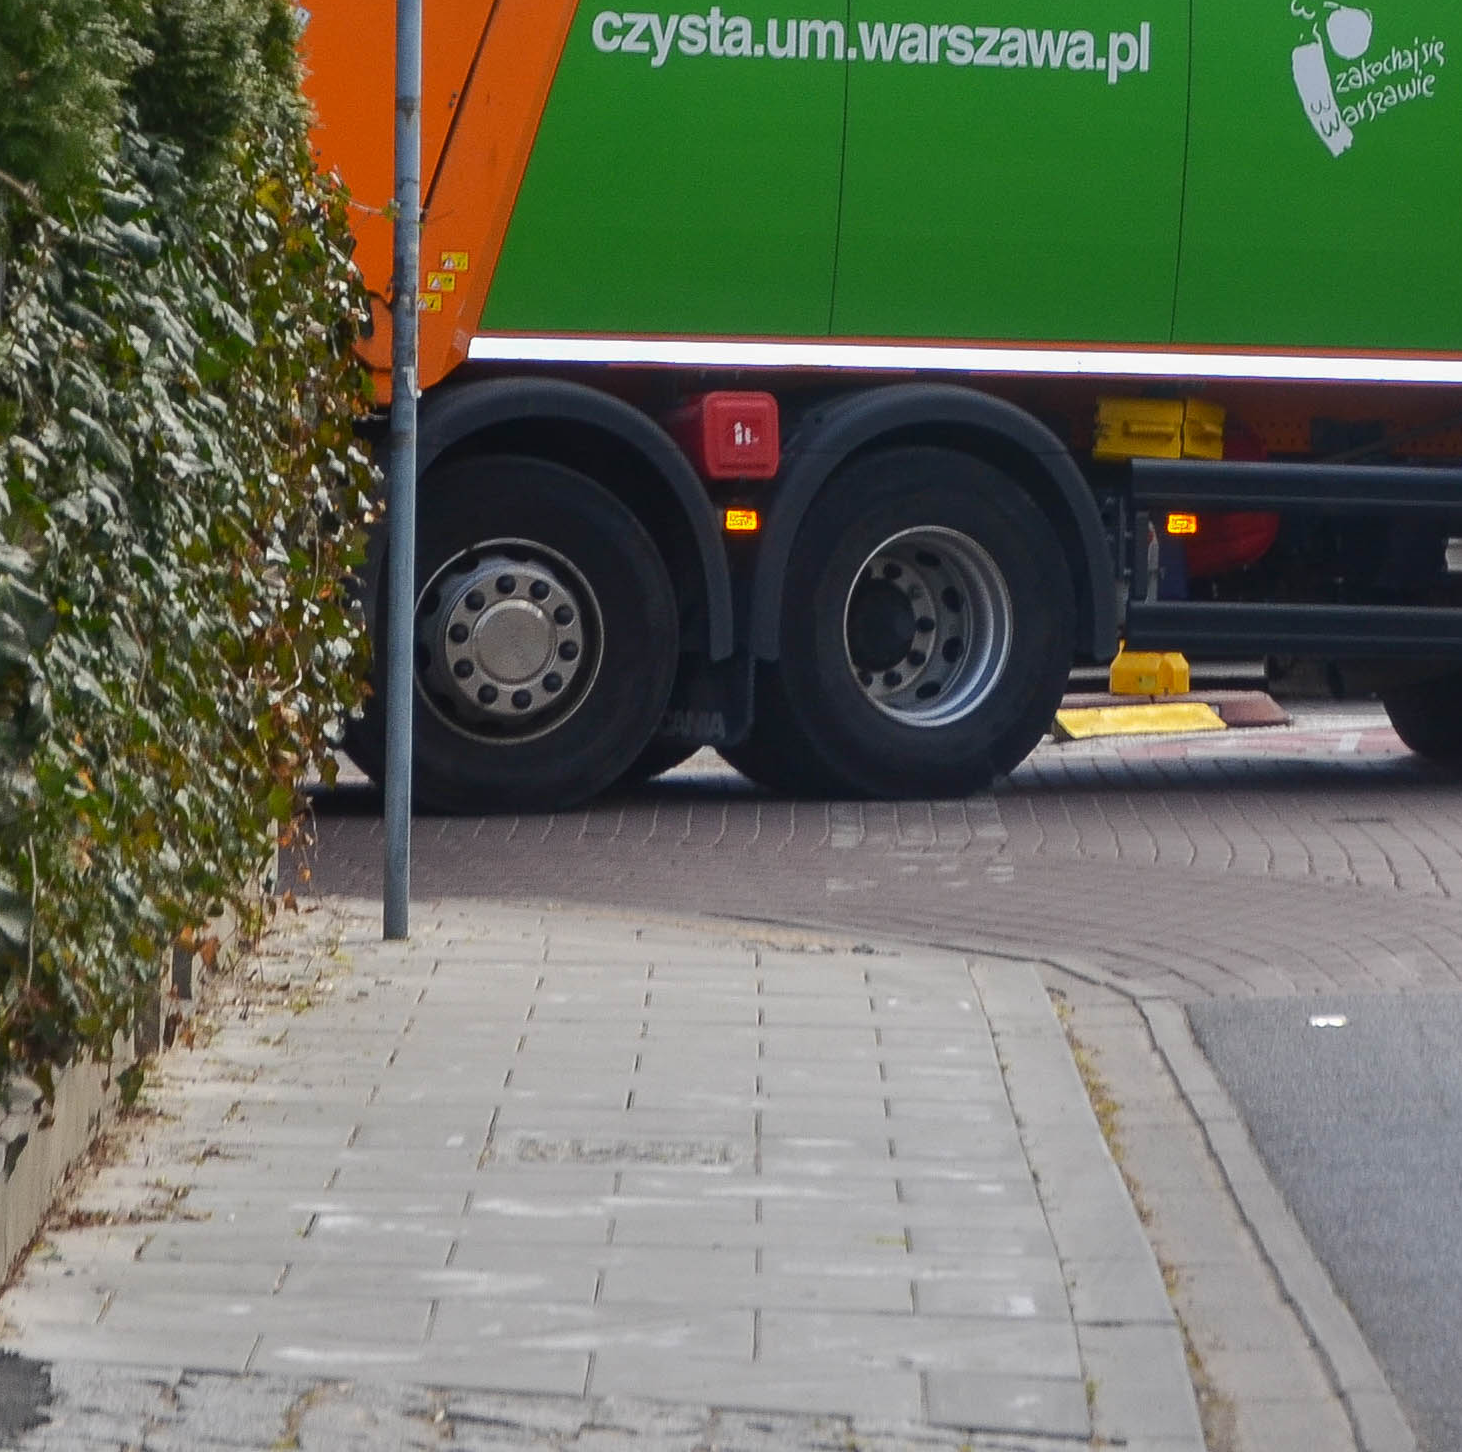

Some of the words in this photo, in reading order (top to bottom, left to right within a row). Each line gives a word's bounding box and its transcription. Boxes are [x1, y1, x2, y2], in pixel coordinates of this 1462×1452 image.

[591, 6, 1151, 84] czysta.um.warszawa.pl
[1336, 36, 1419, 93] zakochaj
[1421, 35, 1445, 67] się
